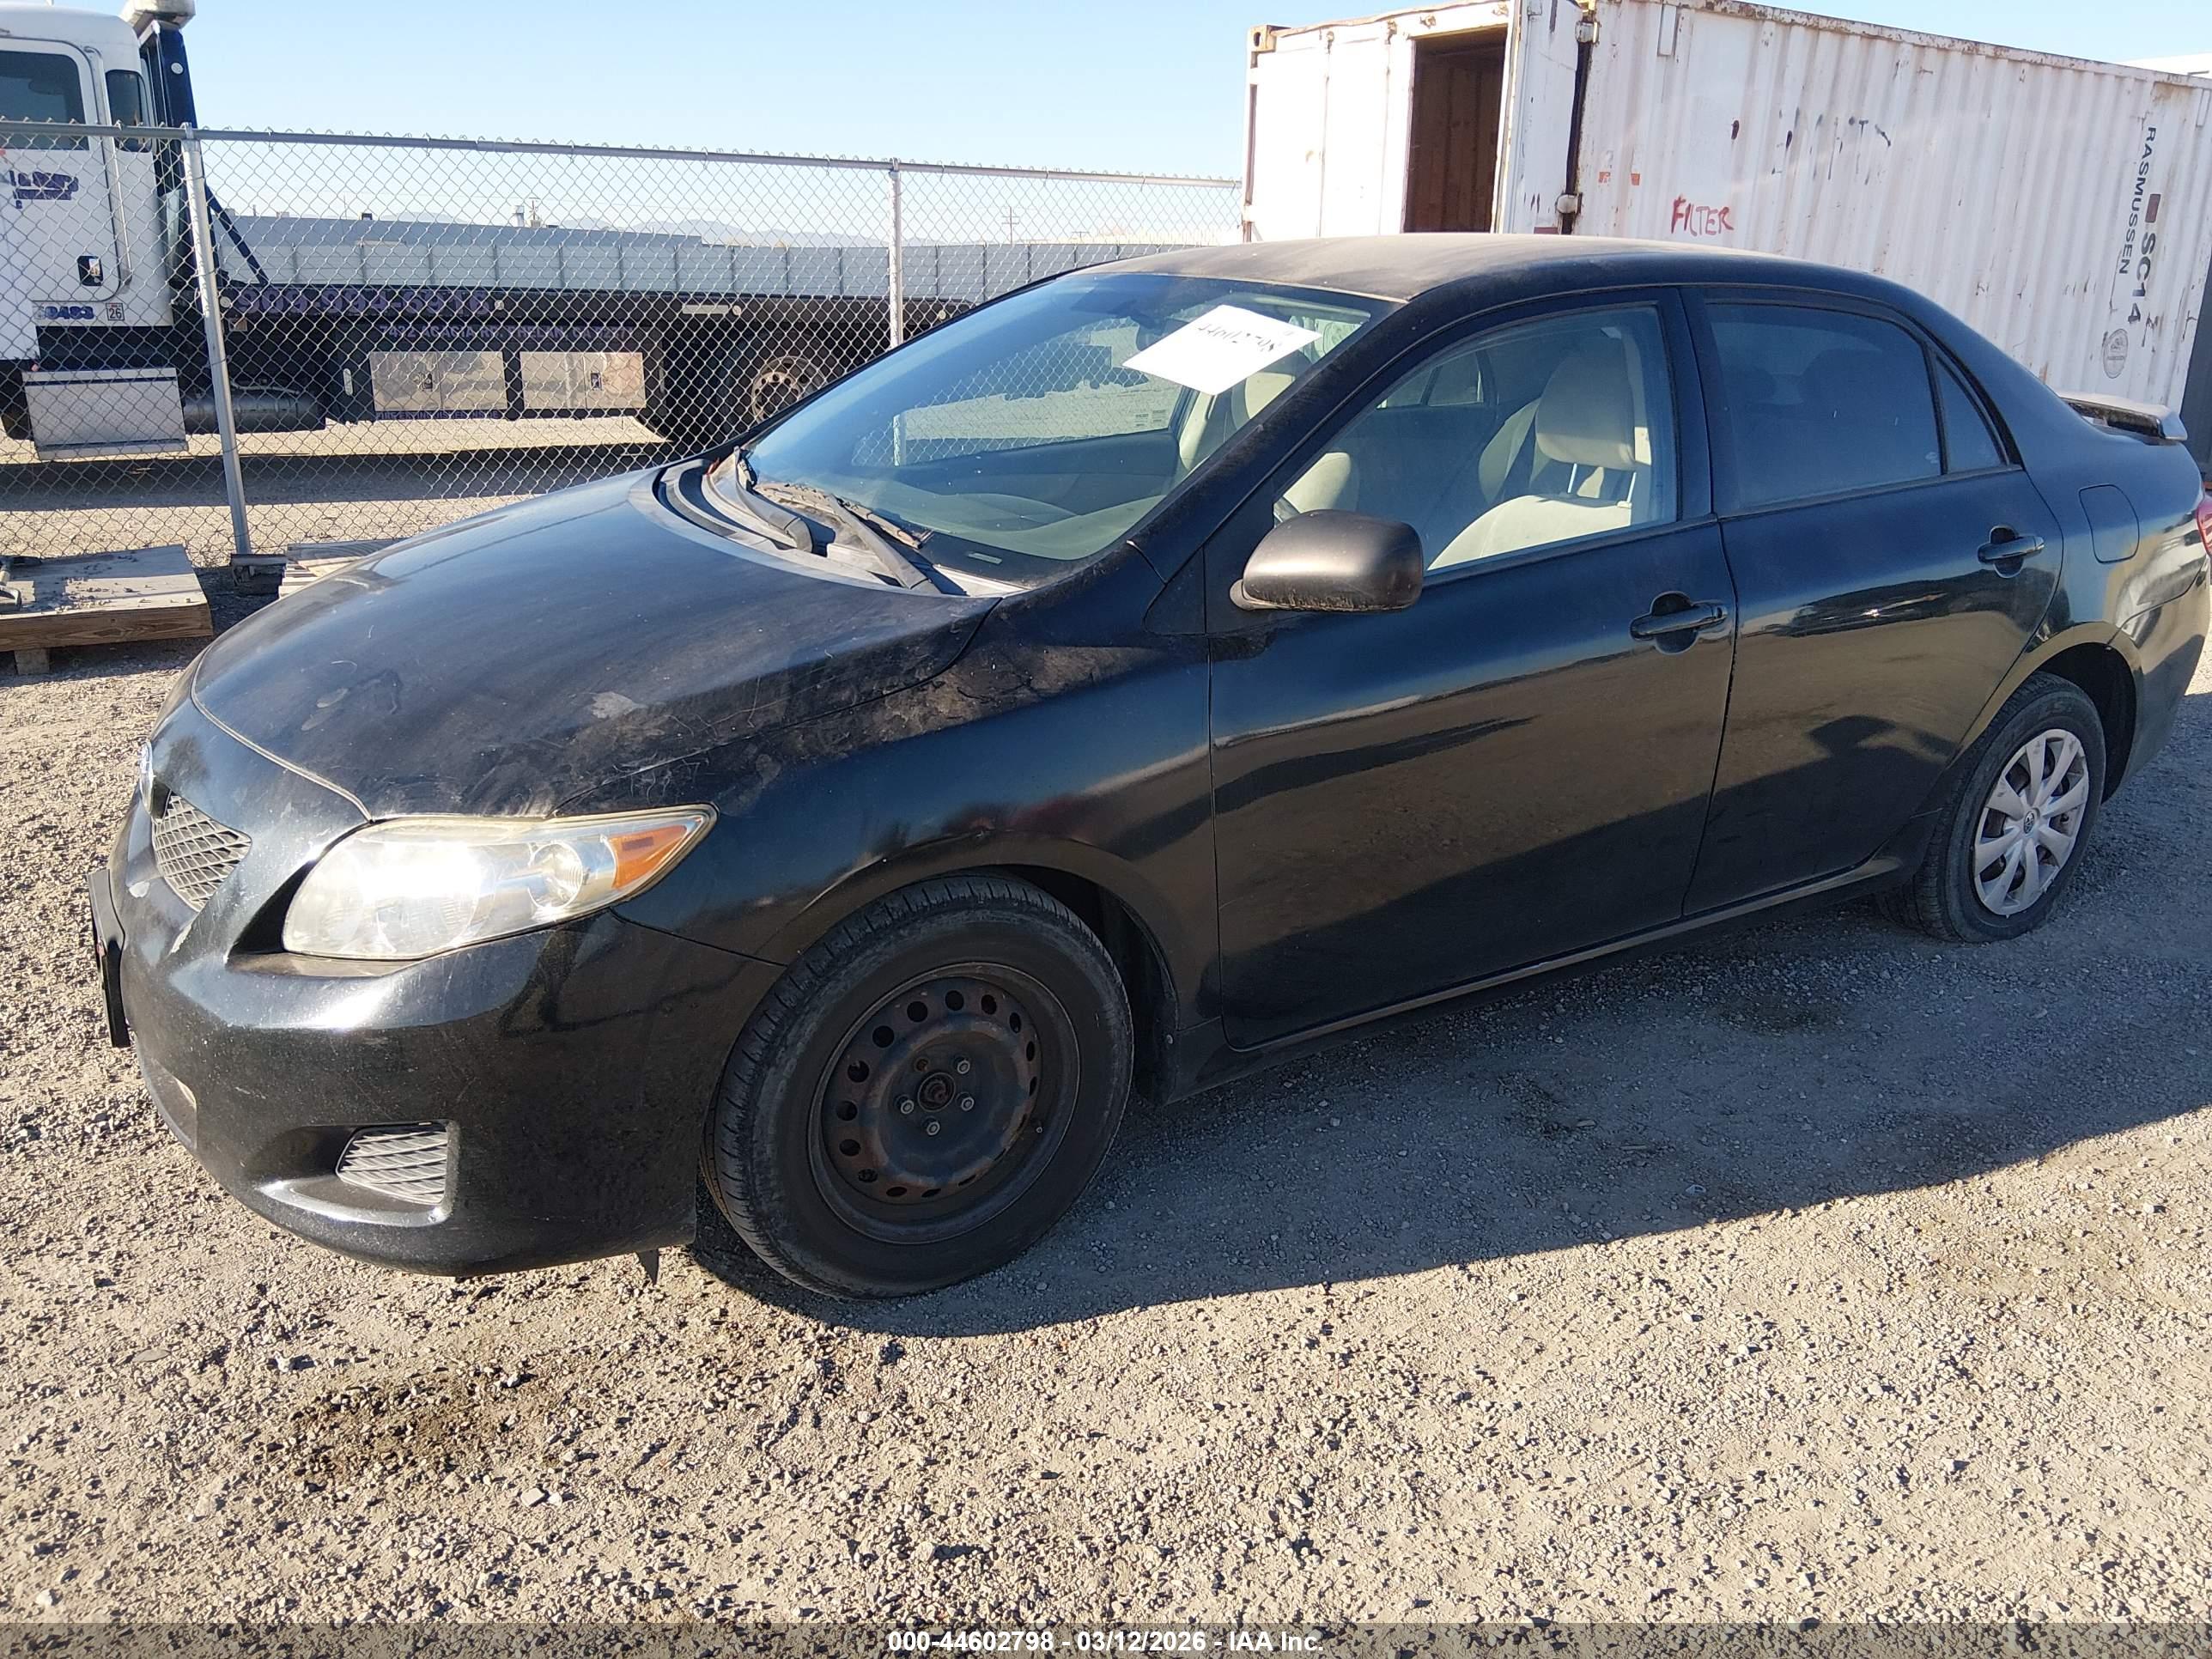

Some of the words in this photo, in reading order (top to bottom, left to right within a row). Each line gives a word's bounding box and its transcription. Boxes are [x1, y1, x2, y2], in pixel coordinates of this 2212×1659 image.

[1670, 194, 1735, 237] FILTER
[2118, 126, 2156, 274] RASMUSSEN
[2127, 232, 2156, 324] SC14
[109, 307, 122, 319] 26
